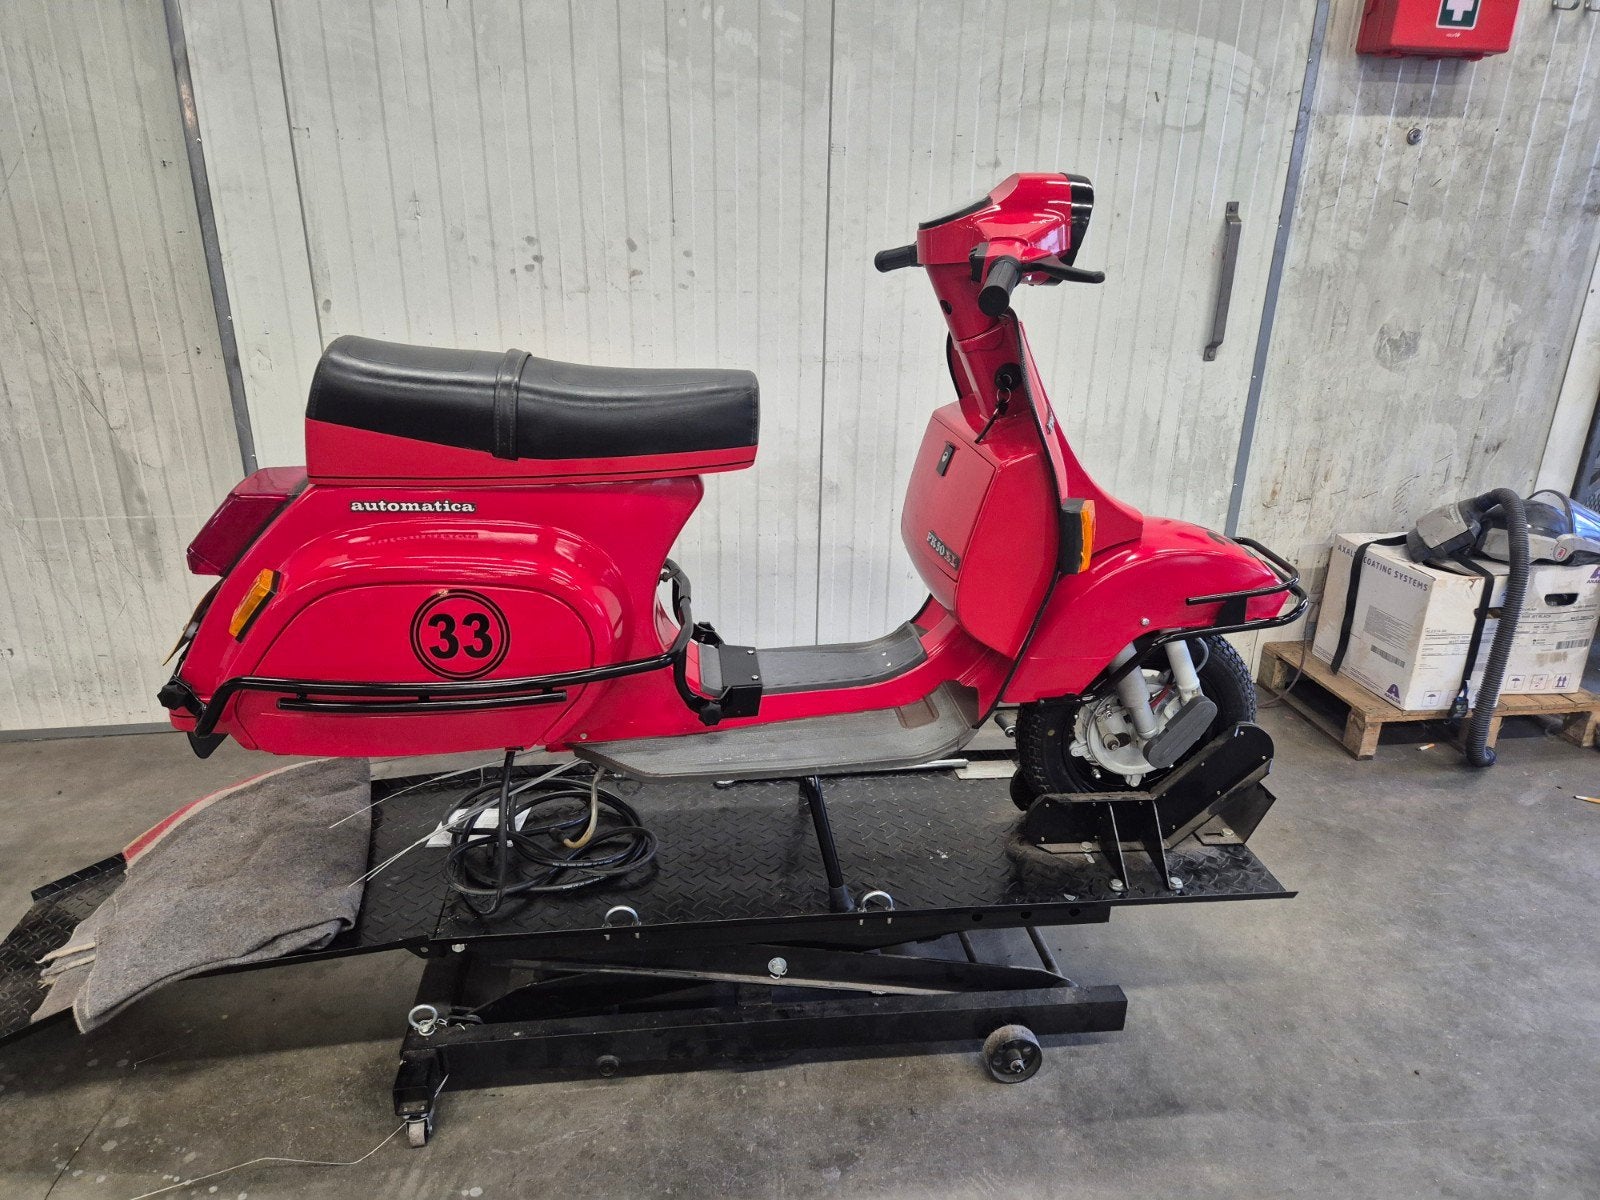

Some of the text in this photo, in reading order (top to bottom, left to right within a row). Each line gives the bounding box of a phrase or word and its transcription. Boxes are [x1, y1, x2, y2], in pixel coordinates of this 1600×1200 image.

[351, 500, 475, 512] automatica
[1337, 544, 1428, 591] AXAL COATING SYSTEMS
[429, 613, 493, 659] 33
